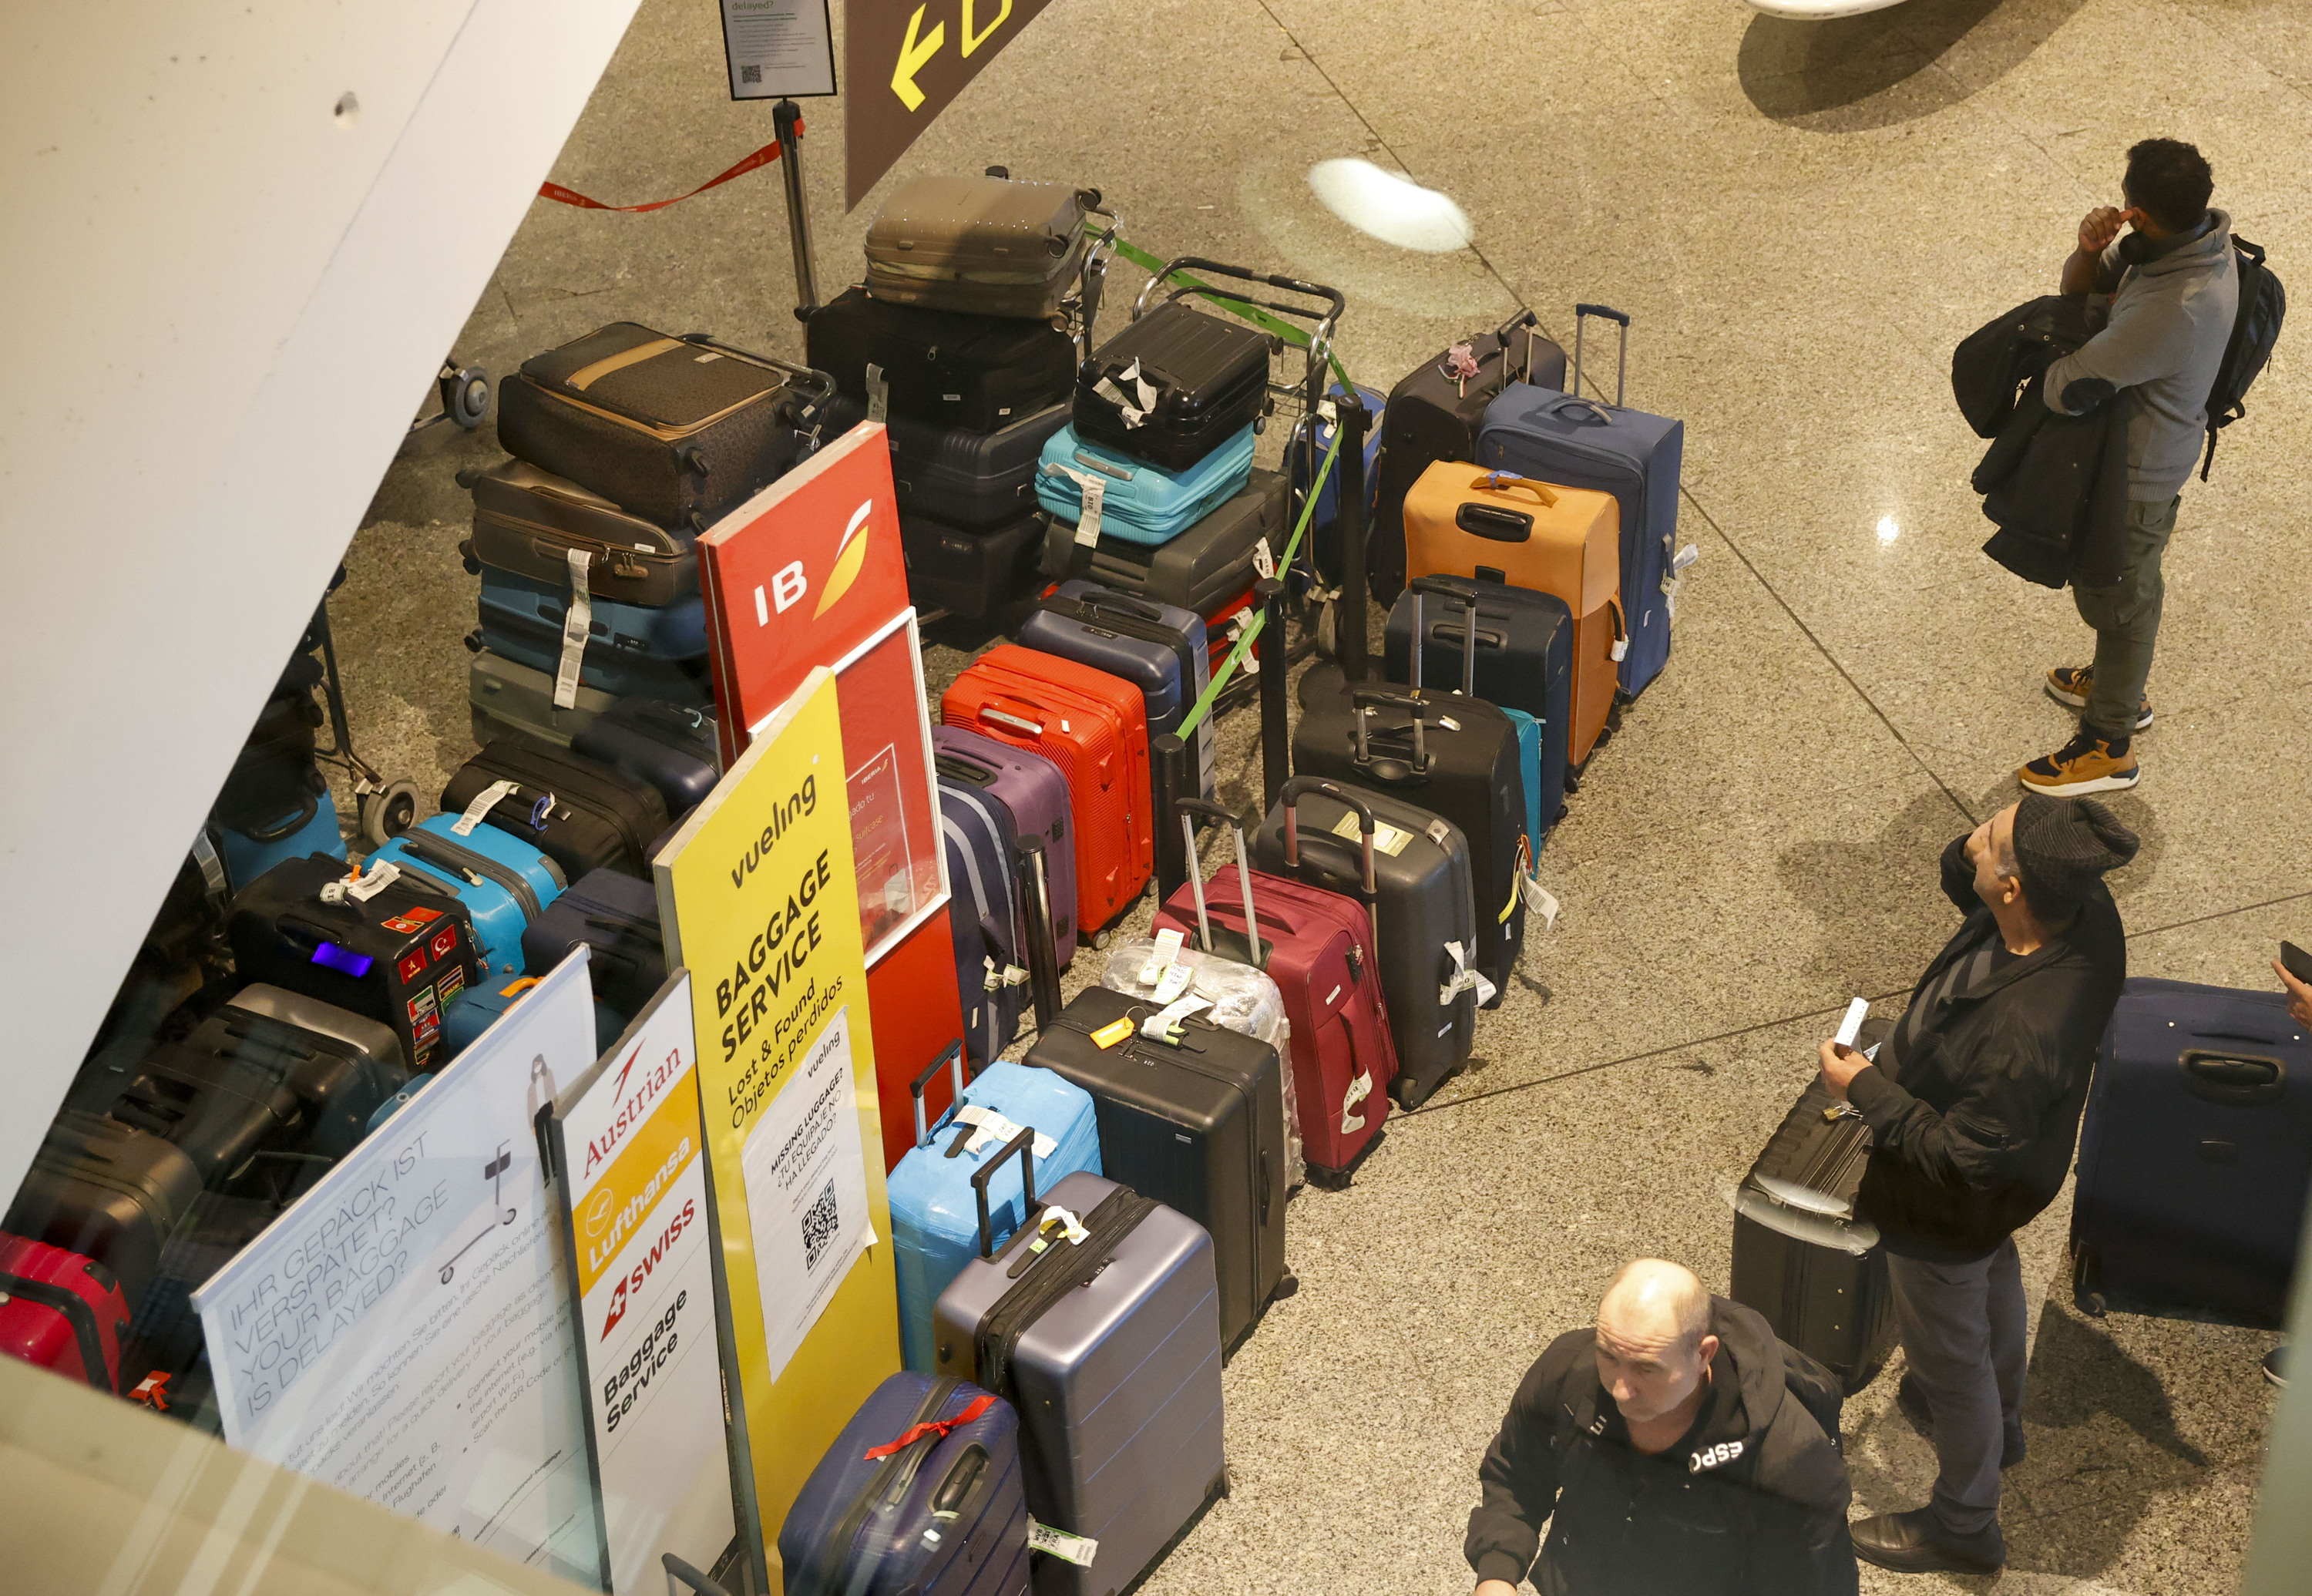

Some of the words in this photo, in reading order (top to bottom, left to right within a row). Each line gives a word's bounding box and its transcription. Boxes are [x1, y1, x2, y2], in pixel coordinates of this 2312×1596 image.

[732, 2, 774, 11] delayed?
[754, 560, 808, 627] IB
[861, 766, 882, 785] IBERIA
[866, 792, 875, 806] tu
[731, 774, 816, 889] vueling
[855, 814, 884, 842] suitcase
[717, 848, 831, 1020] BAGGAGE
[723, 910, 822, 1063] SERVICE
[729, 1057, 758, 1107] Lost
[761, 1039, 773, 1060] &
[775, 976, 815, 1044] Found
[733, 1058, 785, 1130] Objetos
[788, 976, 842, 1062] perdidos
[808, 1030, 840, 1078] vueling
[583, 1048, 682, 1180] Austrian
[771, 1125, 804, 1176] MISSING
[805, 1067, 844, 1129] LUGGAGE?
[785, 1168, 798, 1191] HA
[798, 1113, 838, 1174] LLEGADO?
[792, 1110, 828, 1164] EQUIPAJE
[828, 1090, 842, 1112] NO
[230, 1269, 277, 1332] IHR
[283, 1163, 388, 1284] GEPÄCK
[393, 1130, 429, 1183] IST
[588, 1136, 691, 1274] Lufthansa
[630, 1198, 694, 1295] SWISS
[234, 1190, 397, 1363] VERSPÄTET?
[241, 1299, 319, 1391] YOUR
[325, 1178, 449, 1312] BAGGAGE
[412, 1320, 427, 1342] Sie
[459, 1278, 469, 1295] Ihr
[472, 1241, 508, 1282] Gepäck
[247, 1377, 271, 1420] IS
[277, 1246, 409, 1390] DELAYED?
[371, 1377, 386, 1398] So
[387, 1342, 423, 1382] können
[425, 1324, 441, 1346] Sie
[441, 1305, 461, 1330] eine
[462, 1275, 491, 1309] rasche
[387, 1427, 401, 1447] for
[410, 1394, 435, 1426] quick
[437, 1360, 470, 1398] delivery
[472, 1346, 482, 1362] of
[483, 1326, 502, 1352] your
[505, 1283, 549, 1334] baggage
[388, 1394, 419, 1430] Please
[421, 1365, 451, 1400] report
[452, 1345, 470, 1371] your
[472, 1302, 513, 1347] baggage
[514, 1289, 526, 1307] as
[466, 1360, 500, 1399] Connect
[502, 1339, 521, 1363] your
[524, 1311, 554, 1345] mobile
[556, 1298, 569, 1315] dev
[469, 1396, 482, 1415] the
[484, 1362, 515, 1397] internet
[516, 1340, 537, 1368] (e.g.
[539, 1330, 552, 1347] via
[603, 1289, 687, 1407] Baggage
[607, 1333, 678, 1433] Service
[470, 1398, 496, 1430] airport
[498, 1368, 525, 1400] Wi-Fi)
[472, 1419, 493, 1444] Scan
[494, 1400, 508, 1420] the
[509, 1383, 524, 1405] QR
[526, 1359, 551, 1392] Code
[375, 1453, 410, 1492] mobiles
[382, 1464, 417, 1501] Internet
[418, 1450, 429, 1467] (z.
[430, 1438, 441, 1455] B.
[392, 1462, 436, 1510] Flughafen
[427, 1484, 447, 1507] oder
[1050, 1534, 1060, 1547] FRA
